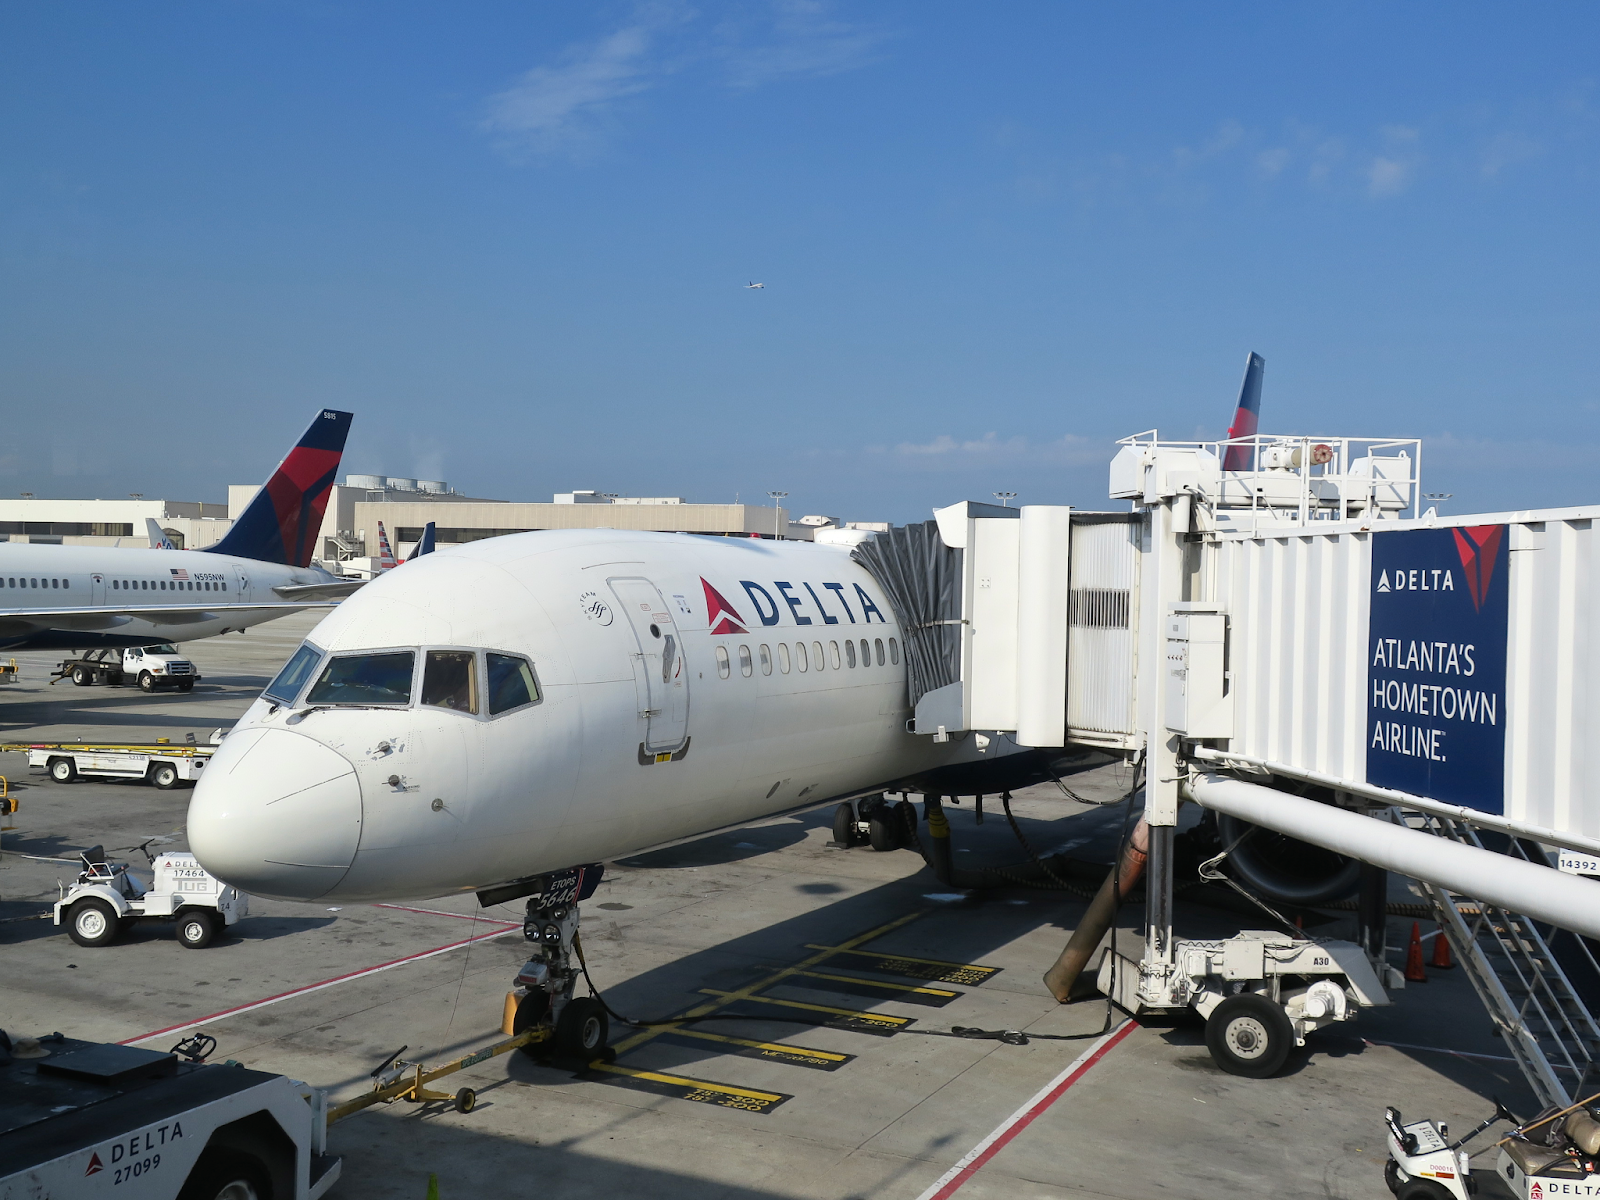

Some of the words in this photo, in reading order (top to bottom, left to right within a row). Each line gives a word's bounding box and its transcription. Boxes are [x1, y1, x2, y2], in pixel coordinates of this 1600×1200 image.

[194, 573, 225, 581] N595NW
[1395, 569, 1454, 591] DELTA
[739, 580, 886, 626] DELTA
[1373, 638, 1475, 677] ATLANTA'S
[1373, 679, 1496, 726] HOMETOWN
[173, 870, 205, 878] 17464
[1560, 859, 1597, 871] 14392
[172, 878, 207, 891] TUG
[551, 876, 577, 891] ETOPS
[536, 886, 578, 910] 5646
[1313, 957, 1329, 966] A30
[112, 1121, 183, 1164] DELTA
[1423, 1130, 1441, 1148] DELTA
[114, 1153, 161, 1185] 27099
